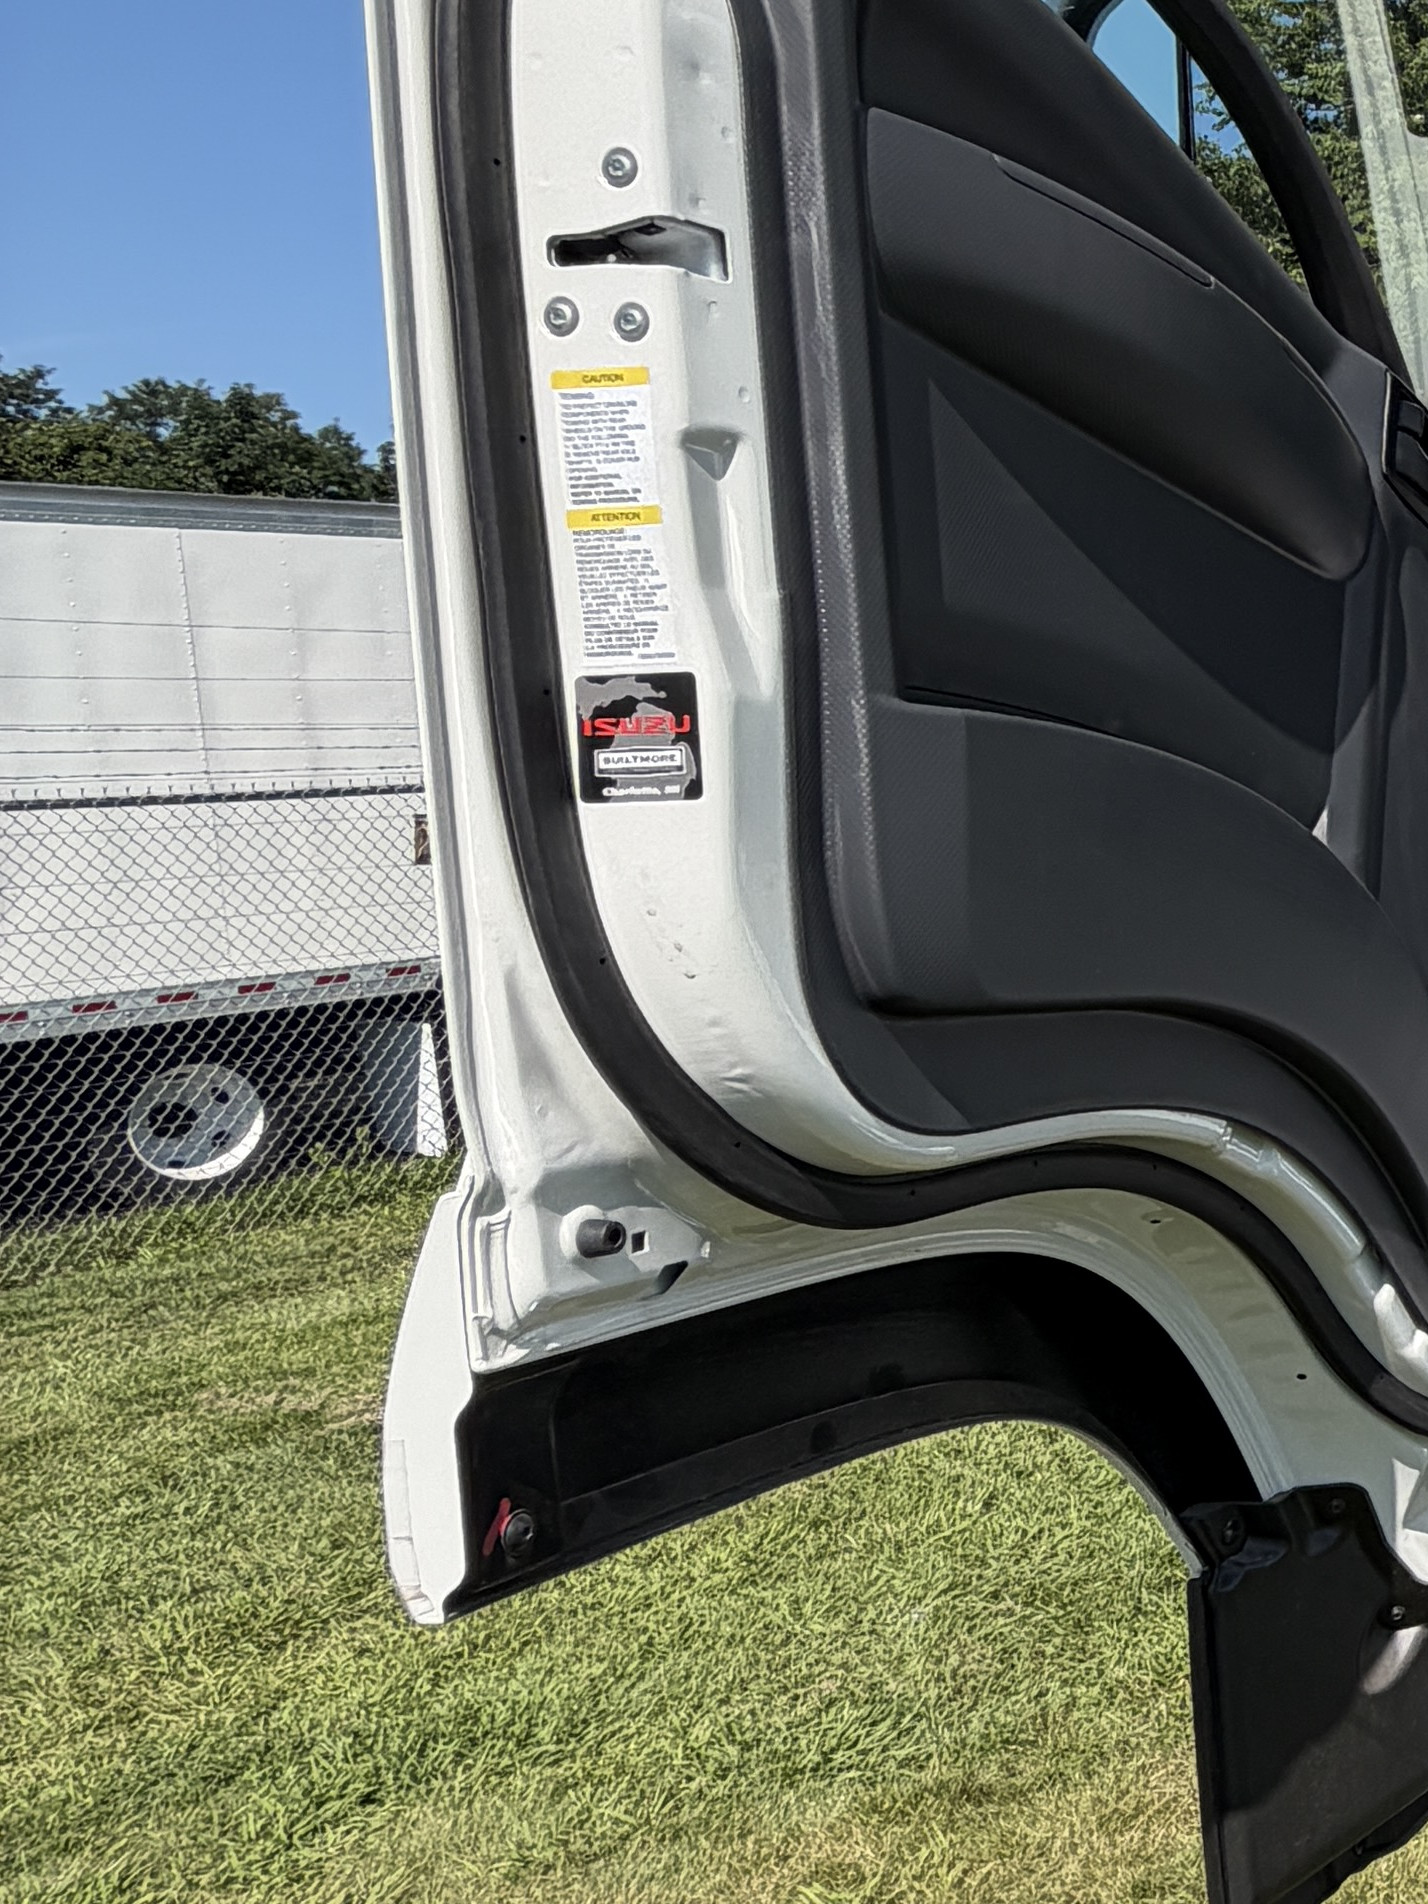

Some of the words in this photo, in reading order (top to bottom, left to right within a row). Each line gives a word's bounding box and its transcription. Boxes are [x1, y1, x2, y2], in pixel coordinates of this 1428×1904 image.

[582, 373, 624, 383] CAUTION
[591, 511, 642, 522] ATTENTION
[583, 714, 691, 736] ISUZU
